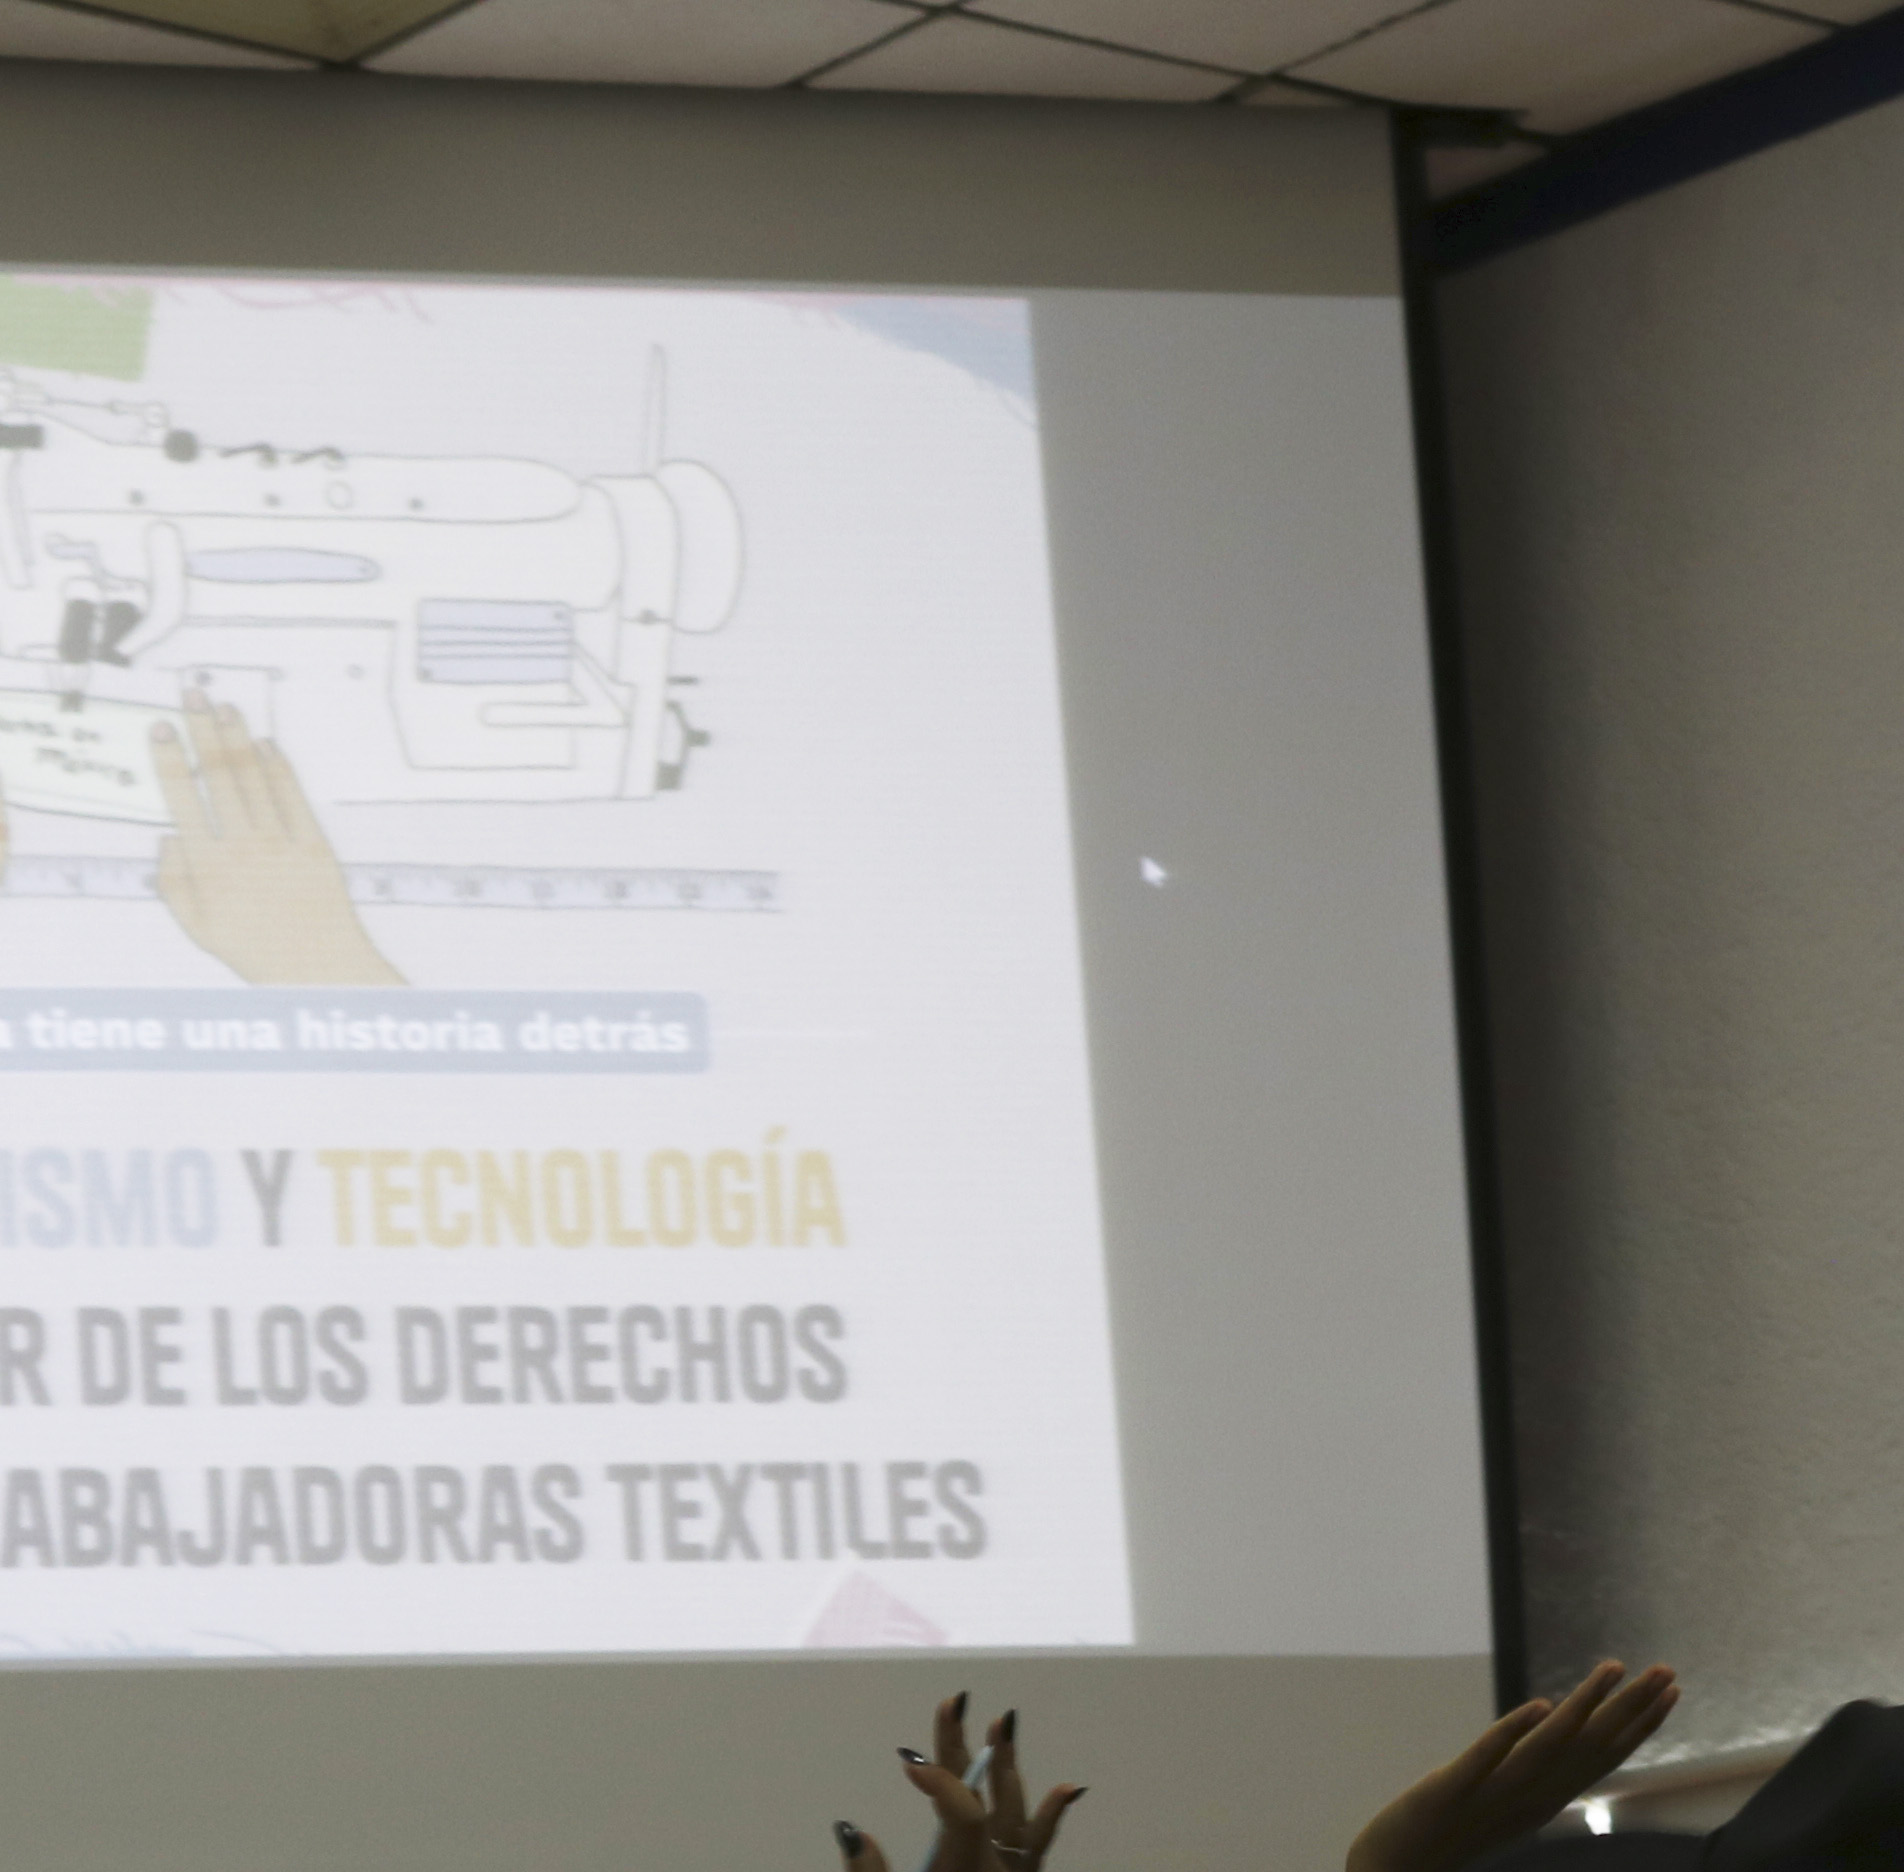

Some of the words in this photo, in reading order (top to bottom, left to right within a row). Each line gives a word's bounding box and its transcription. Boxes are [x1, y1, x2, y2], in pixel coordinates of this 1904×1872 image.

[26, 1009, 165, 1049] tiene
[183, 1020, 282, 1049] una
[299, 1010, 501, 1050] historia
[520, 1009, 688, 1054] detrás
[242, 1150, 293, 1247] Y
[318, 1126, 845, 1248] TECNOLOGÍA
[78, 1306, 186, 1406] DE
[212, 1305, 369, 1406] LOS
[396, 1303, 849, 1405] DERECHOS
[606, 1458, 989, 1560] TEXTILES
